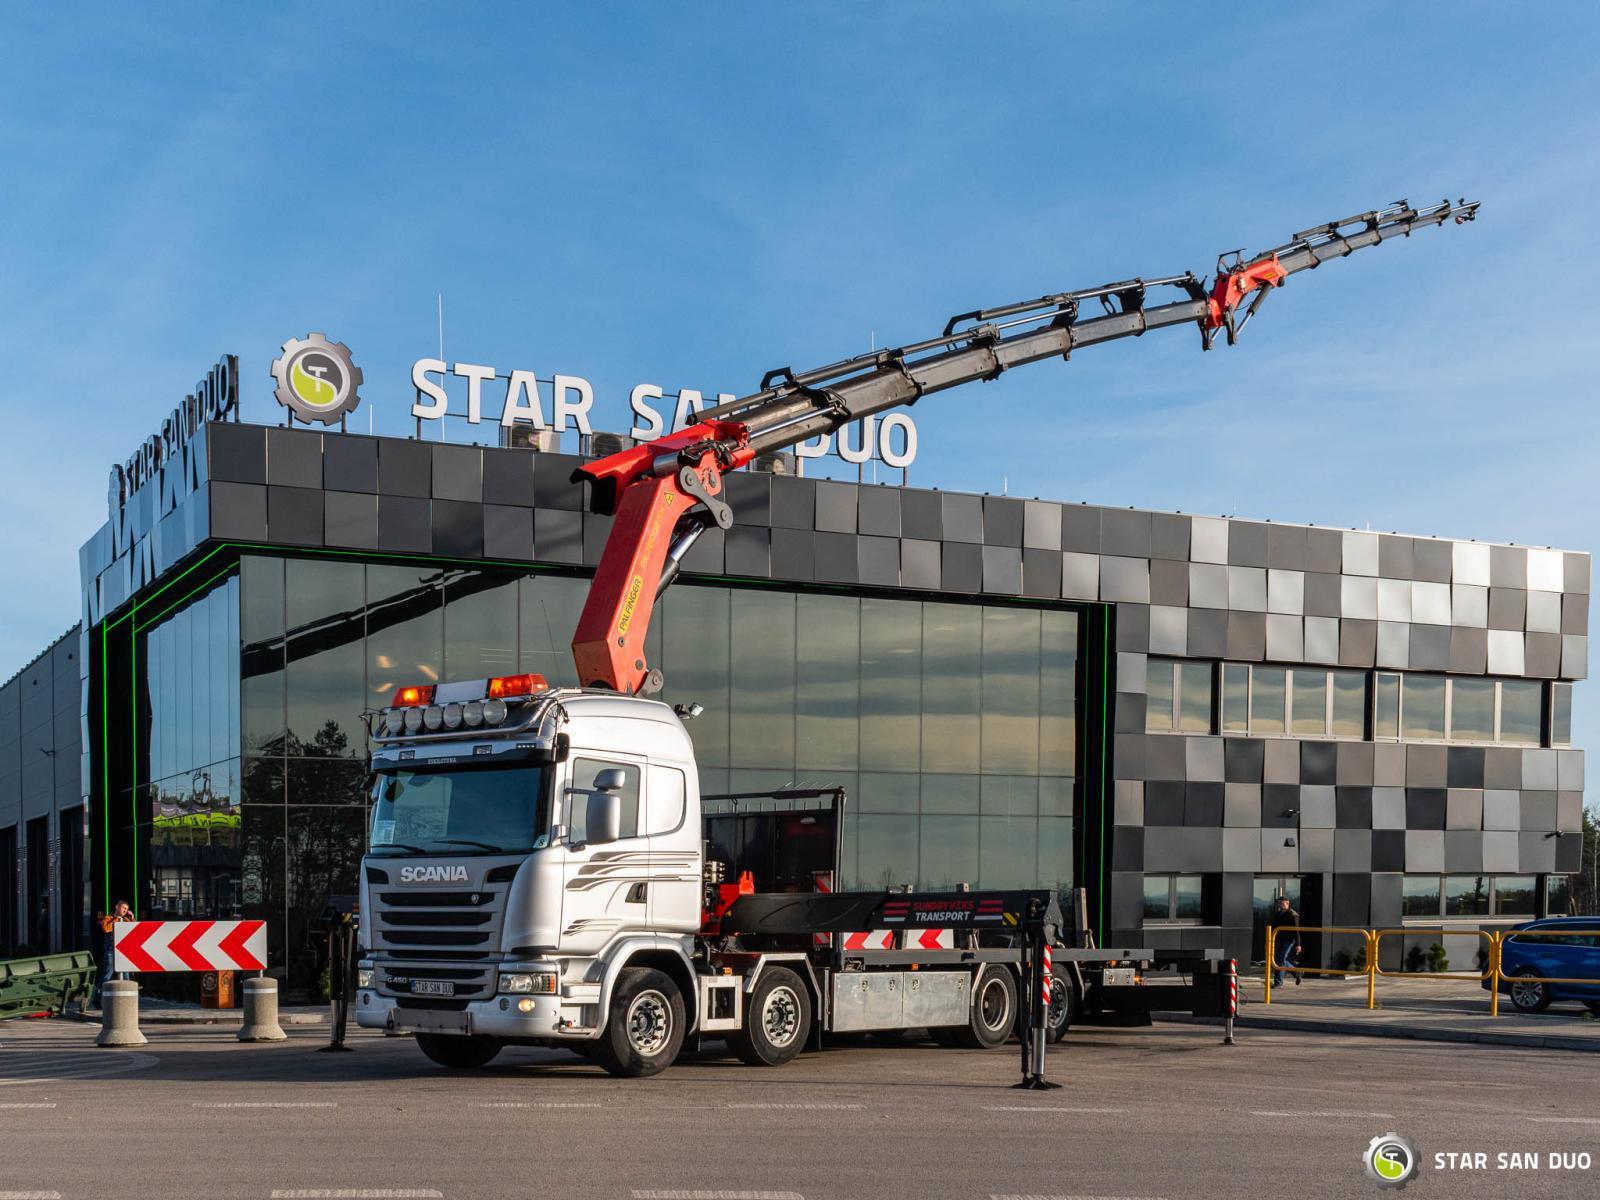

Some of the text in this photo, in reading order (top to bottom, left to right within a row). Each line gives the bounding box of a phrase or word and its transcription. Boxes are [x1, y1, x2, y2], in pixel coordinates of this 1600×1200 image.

[195, 353, 234, 427] DUO
[411, 358, 594, 436] STAR
[619, 577, 642, 632] PALFINGER
[400, 866, 469, 882] SCANIA
[915, 911, 971, 921] TRANSPORT
[416, 981, 430, 993] STAR
